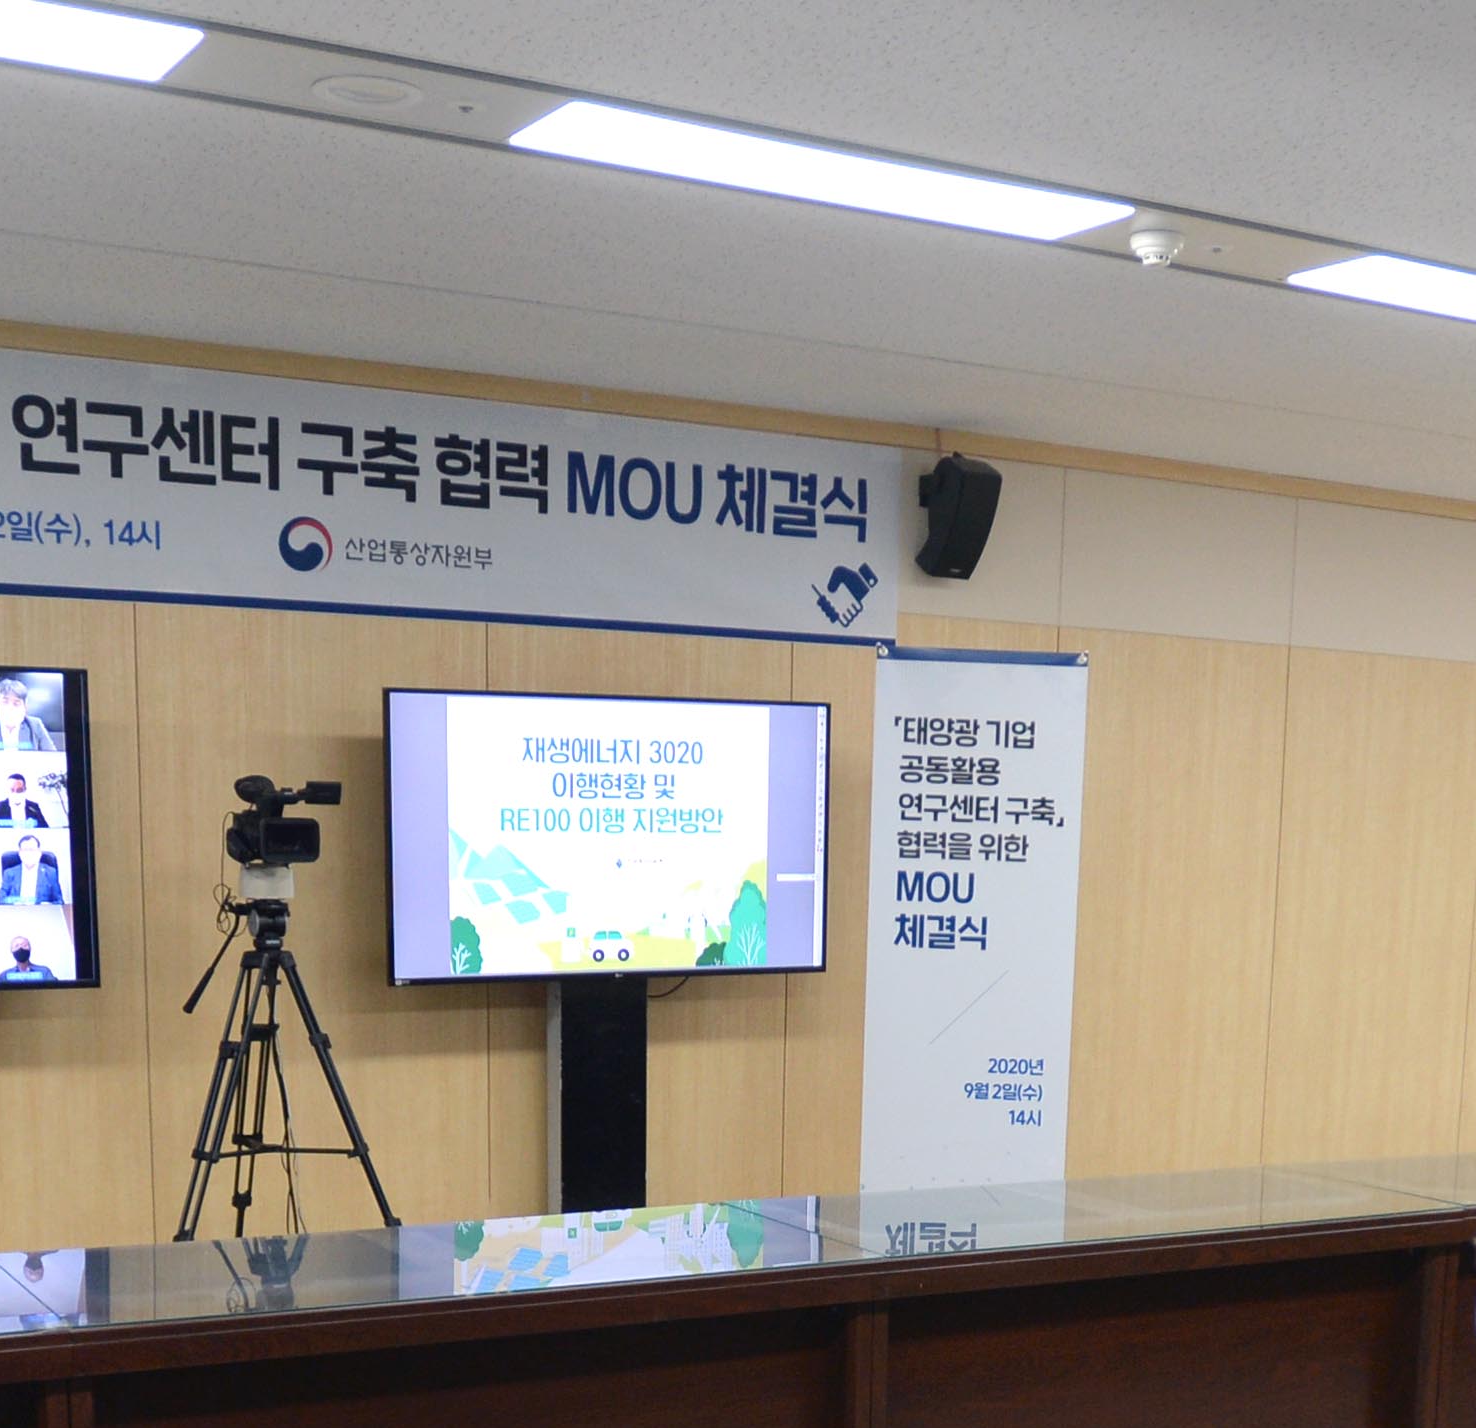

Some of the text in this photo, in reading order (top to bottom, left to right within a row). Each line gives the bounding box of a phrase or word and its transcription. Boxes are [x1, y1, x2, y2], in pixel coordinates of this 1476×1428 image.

[11, 393, 281, 491] 연구센터
[297, 418, 419, 502] 구축
[434, 433, 549, 515] 협력
[566, 451, 701, 527] MOU
[717, 463, 870, 544] 체결식
[103, 517, 163, 553] 14시
[344, 535, 494, 572] 산업통상자원부
[986, 720, 1035, 749] 기업
[522, 737, 704, 765] 재생에너지 3020
[899, 754, 1001, 786] 공동활용
[552, 772, 676, 800] 이행현황 및
[500, 807, 724, 834] RE100 이행 지원방안
[898, 793, 999, 824] 연구센터
[897, 830, 1029, 862] 협력을 위한
[896, 870, 975, 903] MOU
[894, 913, 988, 950] 체결식
[988, 1058, 1044, 1076] 2020년
[964, 1082, 1043, 1101] 9월 2일(수)
[1008, 1110, 1042, 1126] 14시
